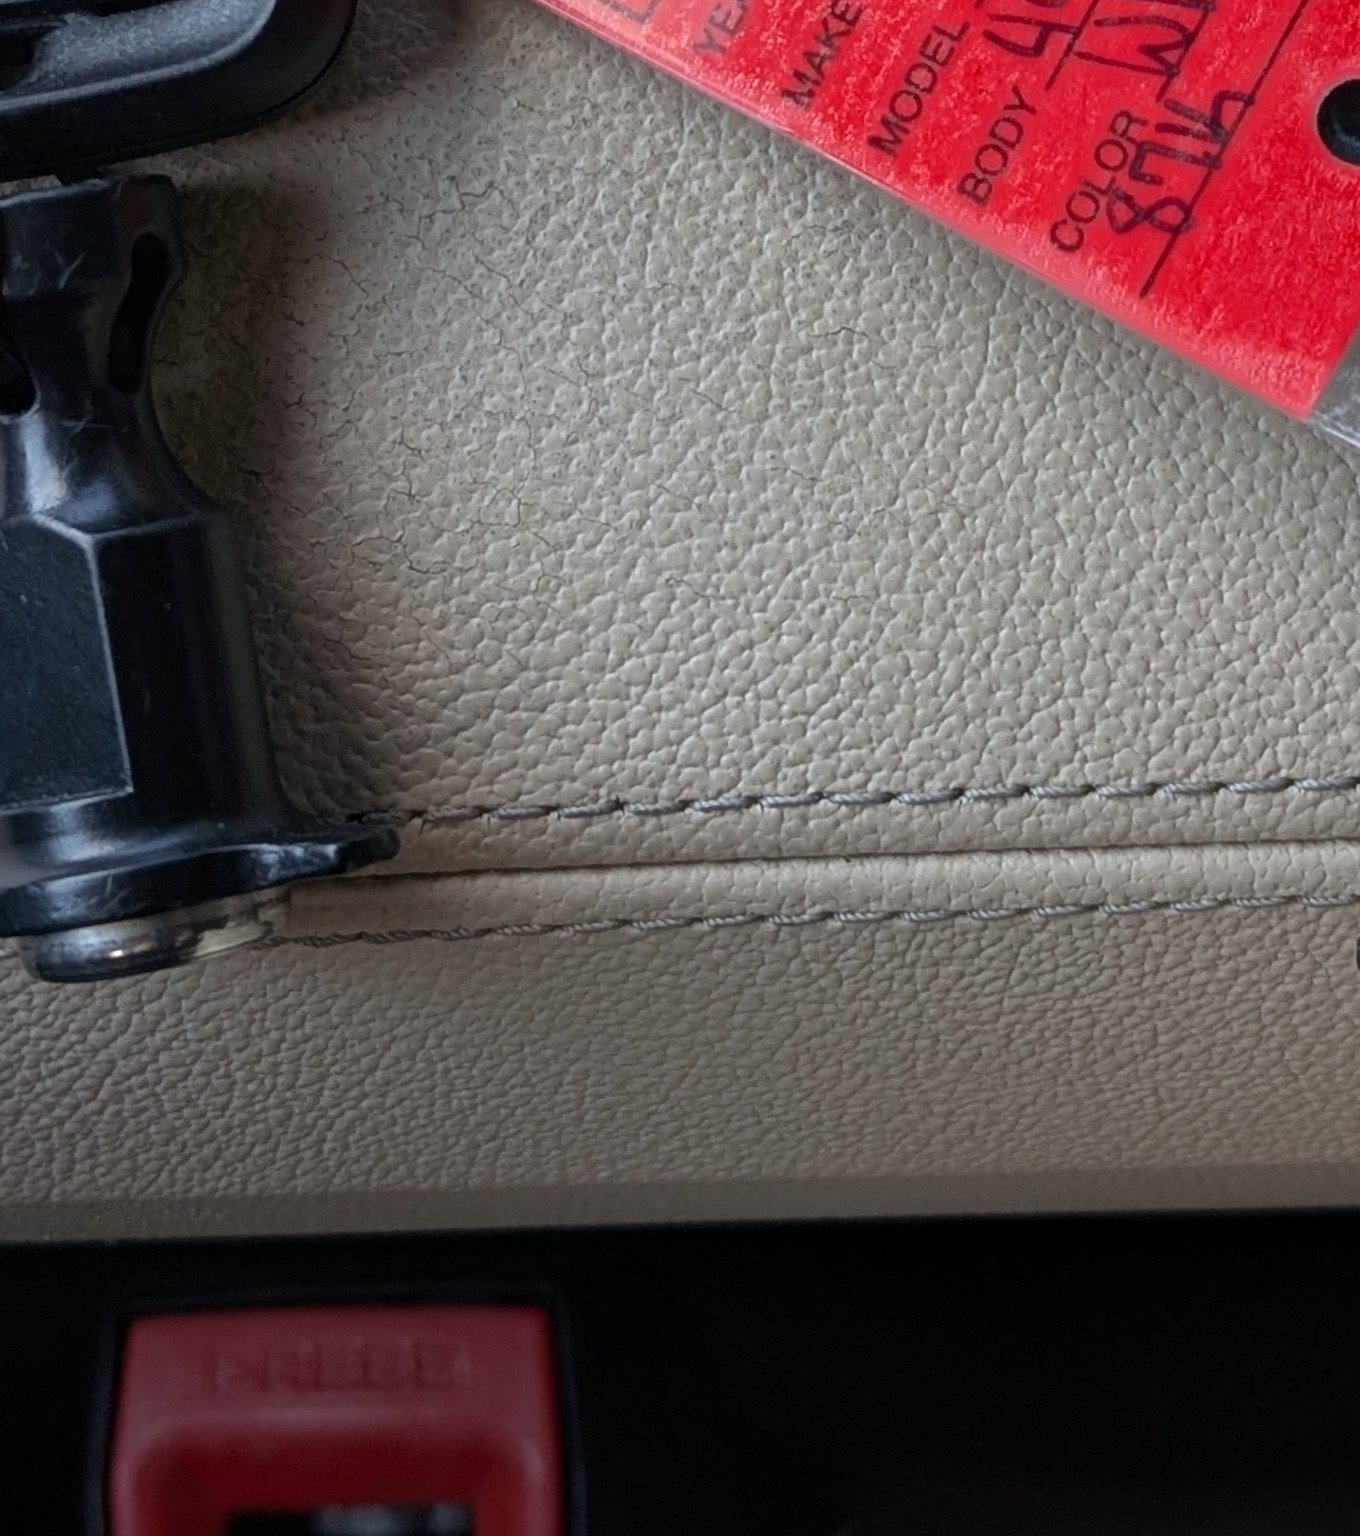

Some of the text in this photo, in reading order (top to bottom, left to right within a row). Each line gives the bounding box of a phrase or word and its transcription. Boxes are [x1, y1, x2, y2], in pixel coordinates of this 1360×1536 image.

[867, 20, 970, 158] MODEL
[955, 84, 1037, 205] BODY
[1049, 109, 1148, 253] COLOR
